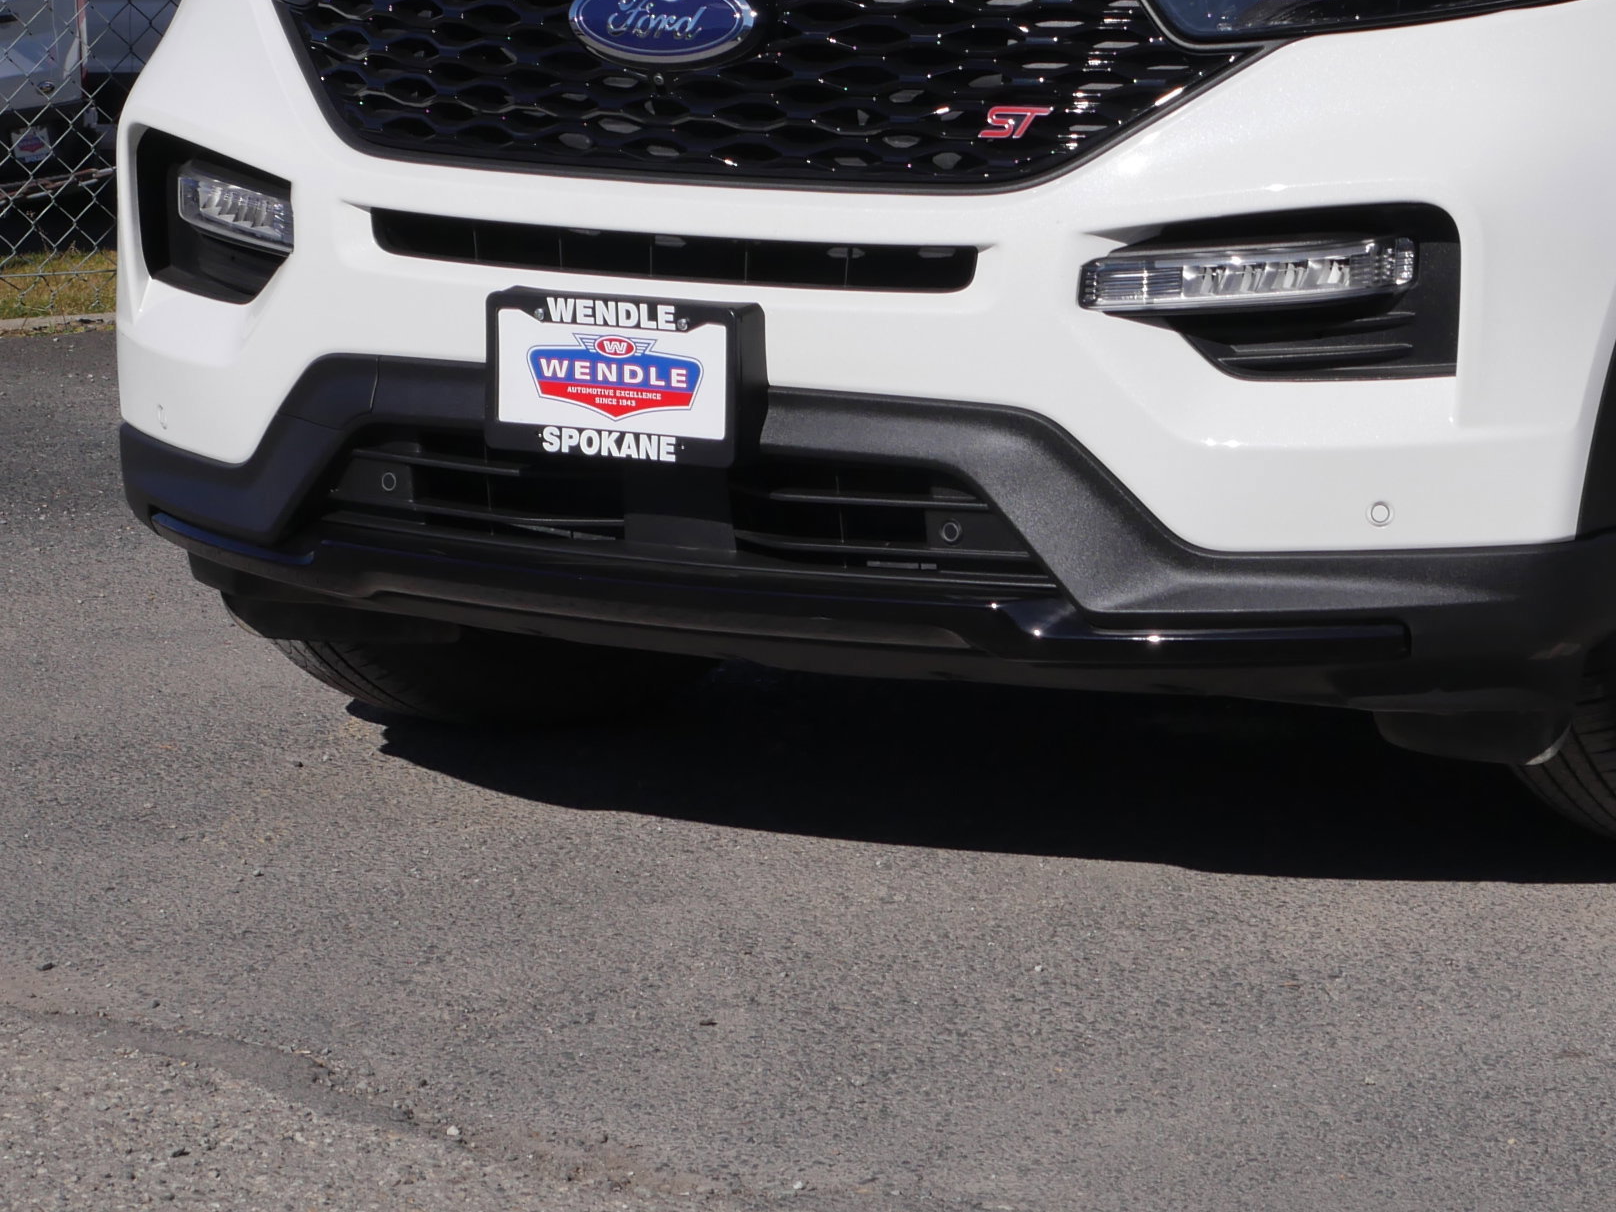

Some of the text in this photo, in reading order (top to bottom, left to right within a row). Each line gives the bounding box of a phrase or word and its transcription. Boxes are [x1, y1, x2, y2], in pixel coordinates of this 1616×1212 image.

[978, 106, 1054, 139] ST
[546, 297, 677, 331] WENDLE
[540, 358, 688, 388] WENDLE
[567, 386, 662, 400] AUTOMOTIVE EXCELLENCE
[595, 397, 636, 407] SINCE 1943
[542, 426, 676, 462] SPOKANE
